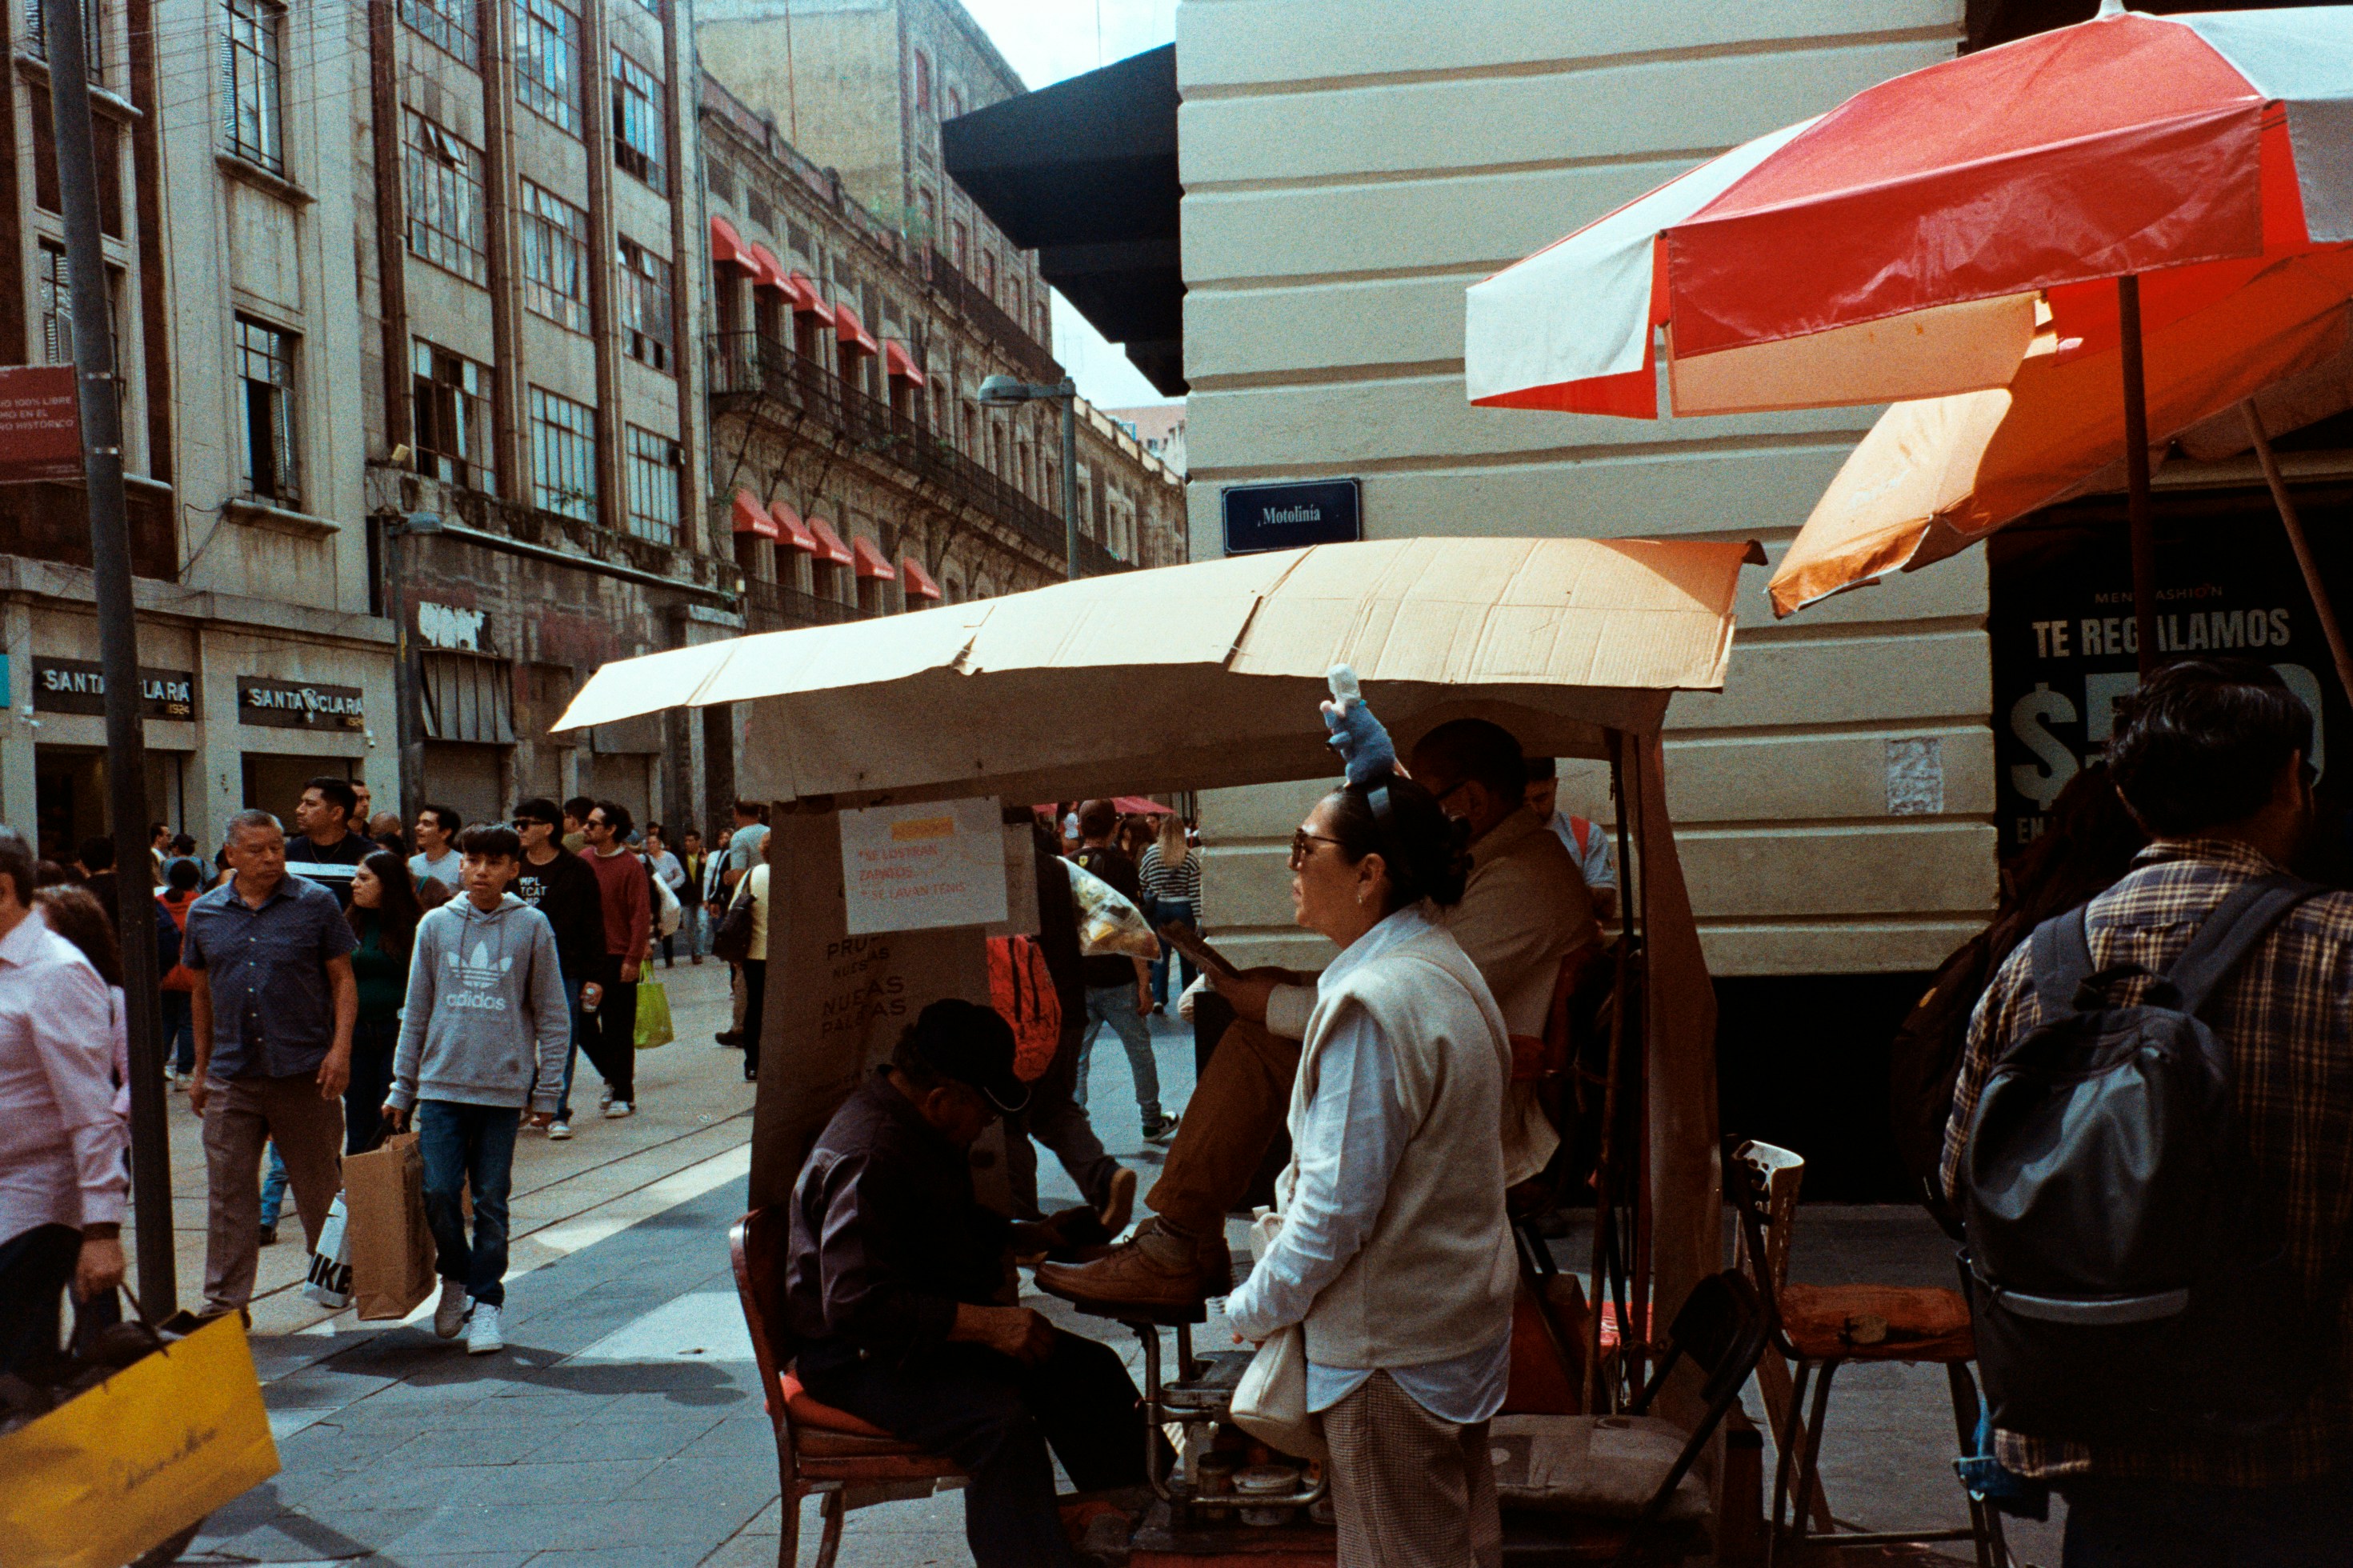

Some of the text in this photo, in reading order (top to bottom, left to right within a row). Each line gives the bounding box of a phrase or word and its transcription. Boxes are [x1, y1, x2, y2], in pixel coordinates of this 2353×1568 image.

[42, 397, 72, 406] LIBRE
[19, 410, 34, 418] EN
[1263, 503, 1321, 525] Motolinía
[2094, 585, 2223, 604] MEN ASHION
[2032, 608, 2291, 658] TE REGLAMOS
[142, 678, 191, 702] LARA
[248, 687, 364, 715] SANTA CLARA
[446, 990, 506, 1011] adidas
[307, 1253, 353, 1294] IKE
